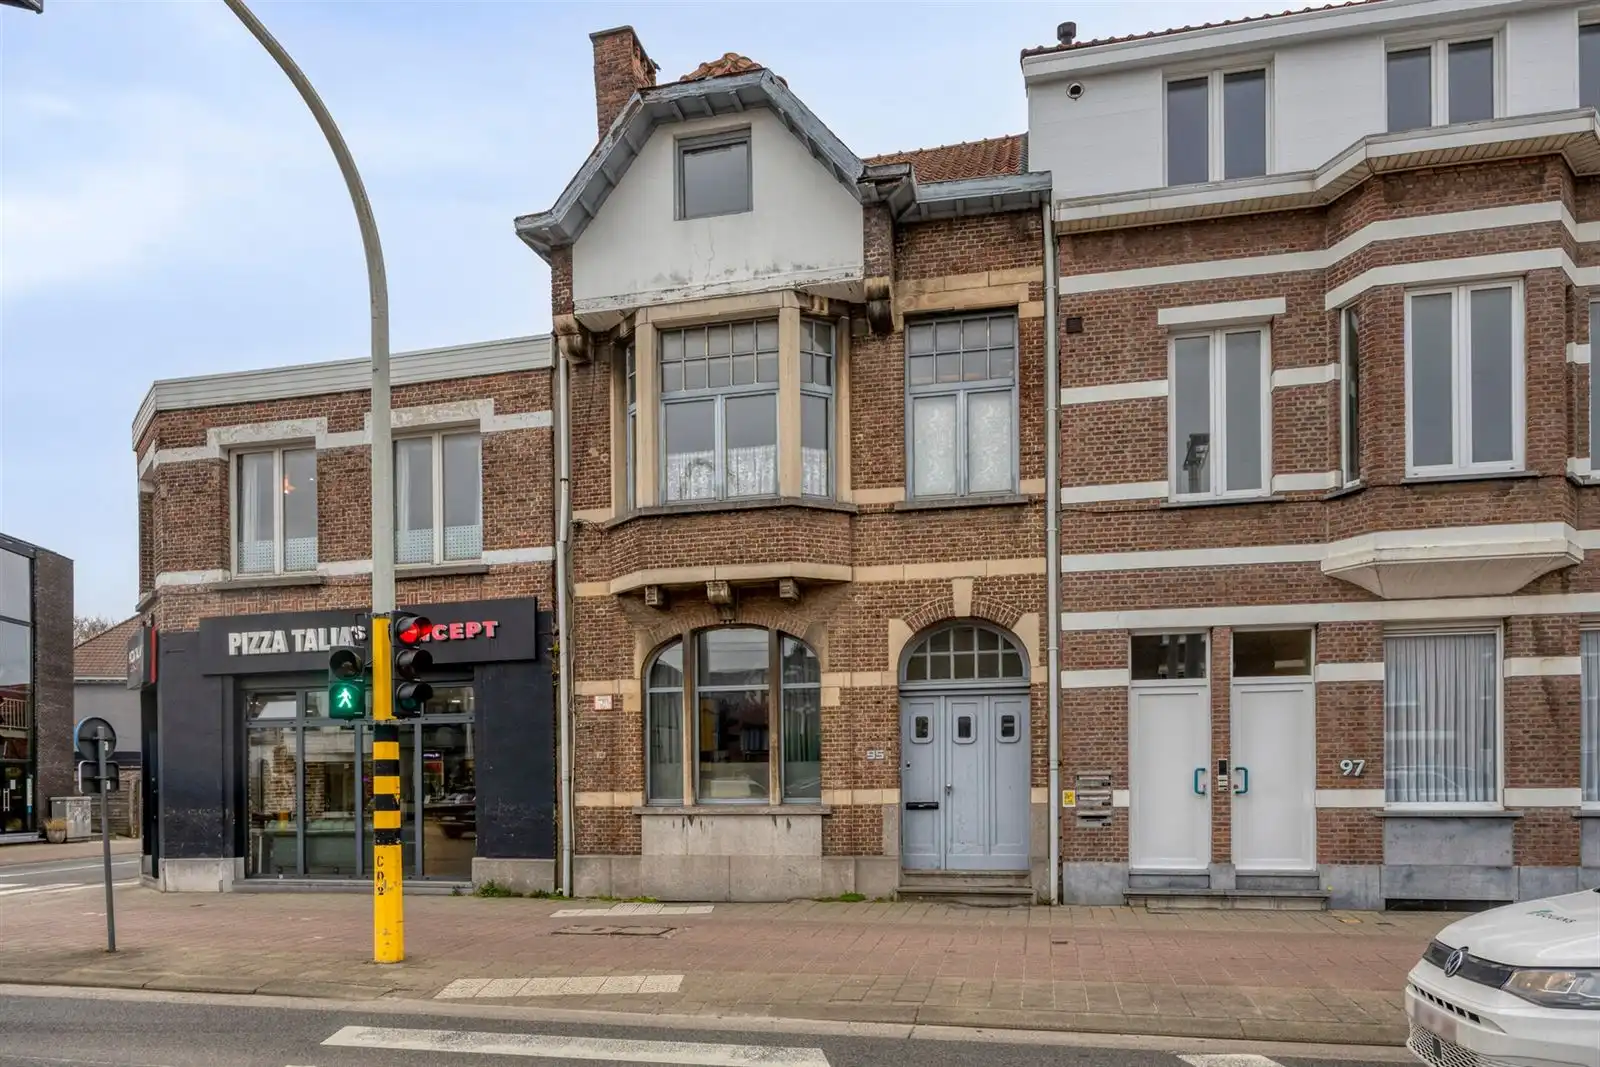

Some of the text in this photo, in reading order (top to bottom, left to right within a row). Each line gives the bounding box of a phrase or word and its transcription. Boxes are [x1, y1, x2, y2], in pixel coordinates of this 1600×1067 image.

[228, 630, 289, 656] PIZZA
[866, 750, 884, 760] 95
[1340, 759, 1365, 777] 97
